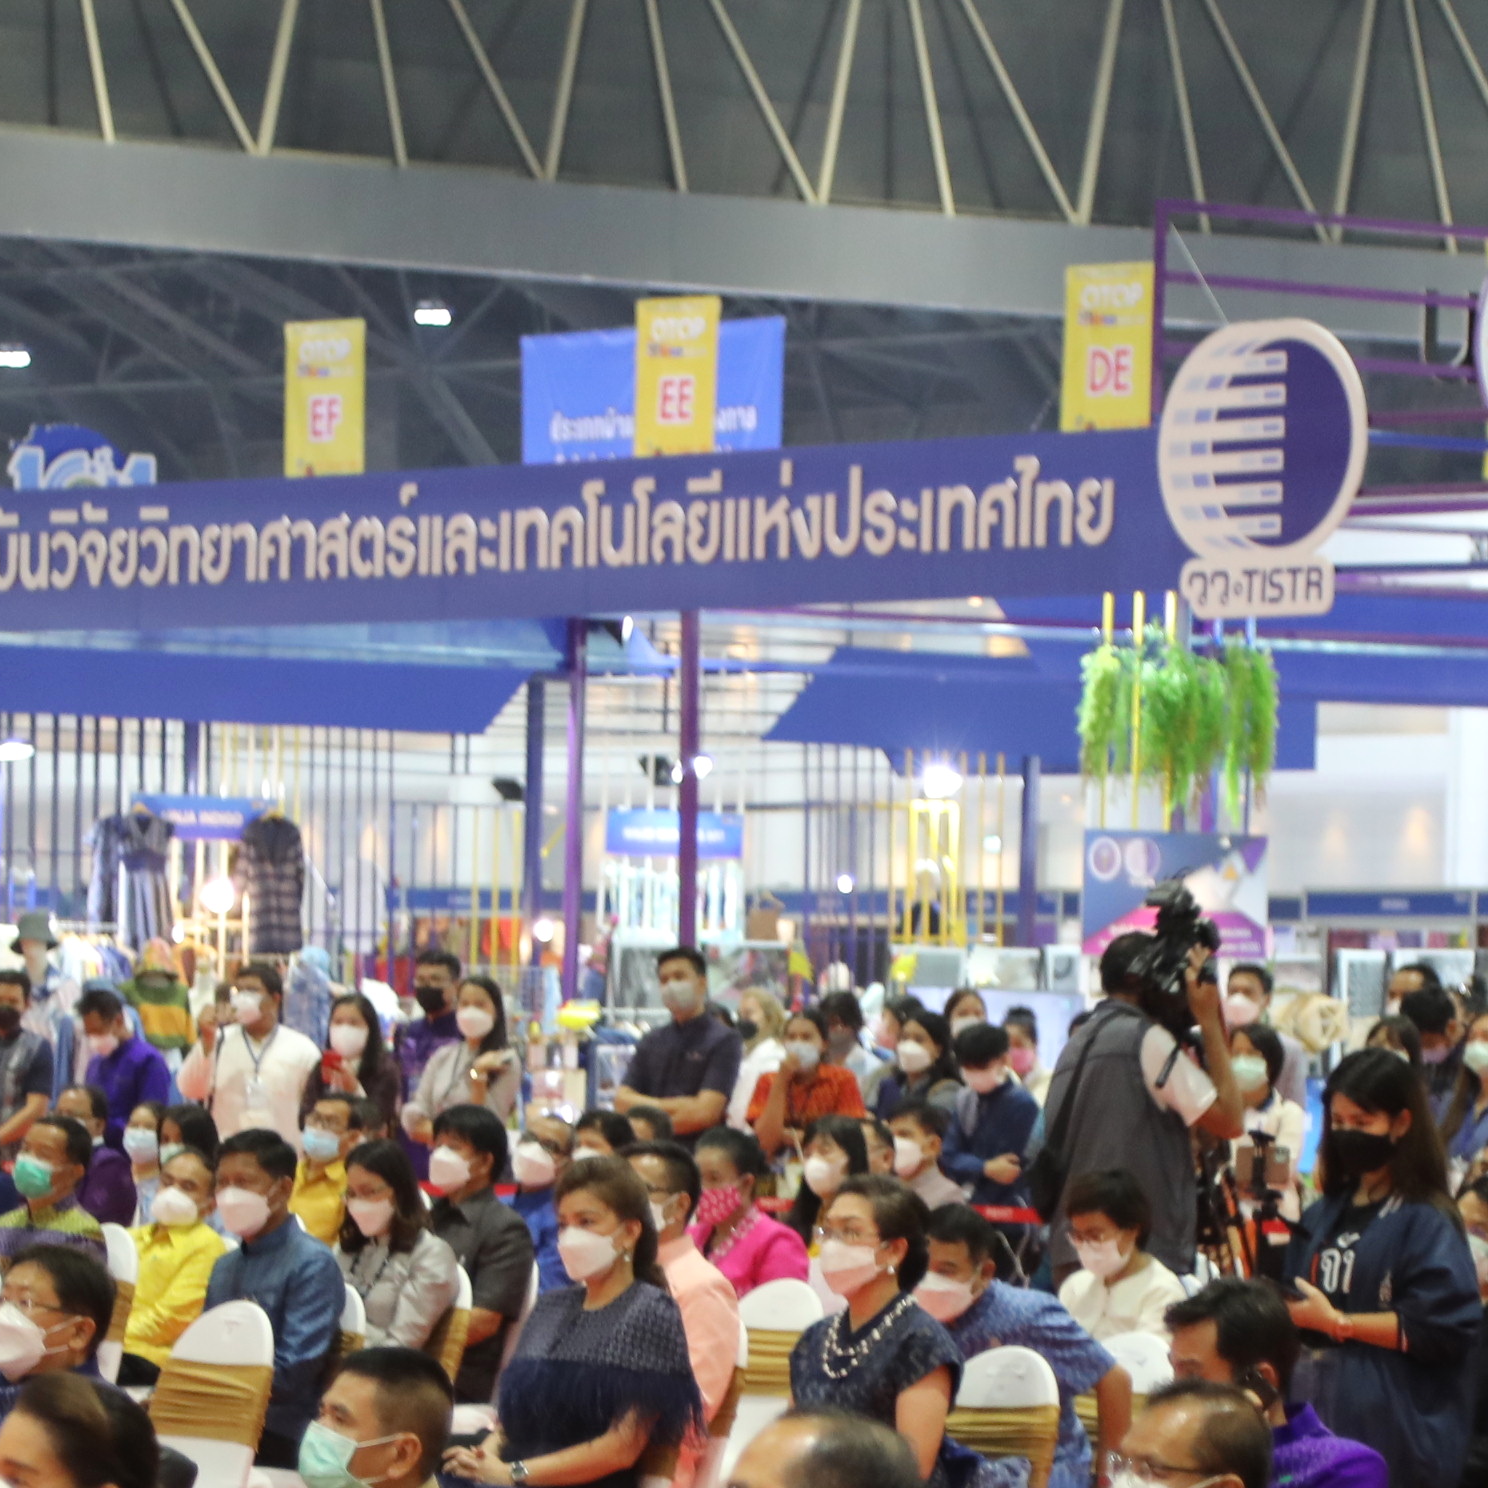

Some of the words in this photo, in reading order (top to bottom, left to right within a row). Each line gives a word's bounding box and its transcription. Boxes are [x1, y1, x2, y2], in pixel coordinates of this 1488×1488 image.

[1080, 282, 1144, 310] OTOP
[651, 317, 706, 343] OTOP
[1086, 345, 1133, 396] DE
[308, 396, 342, 441] EF
[658, 375, 695, 424] EE
[1243, 565, 1323, 603] TISTR
